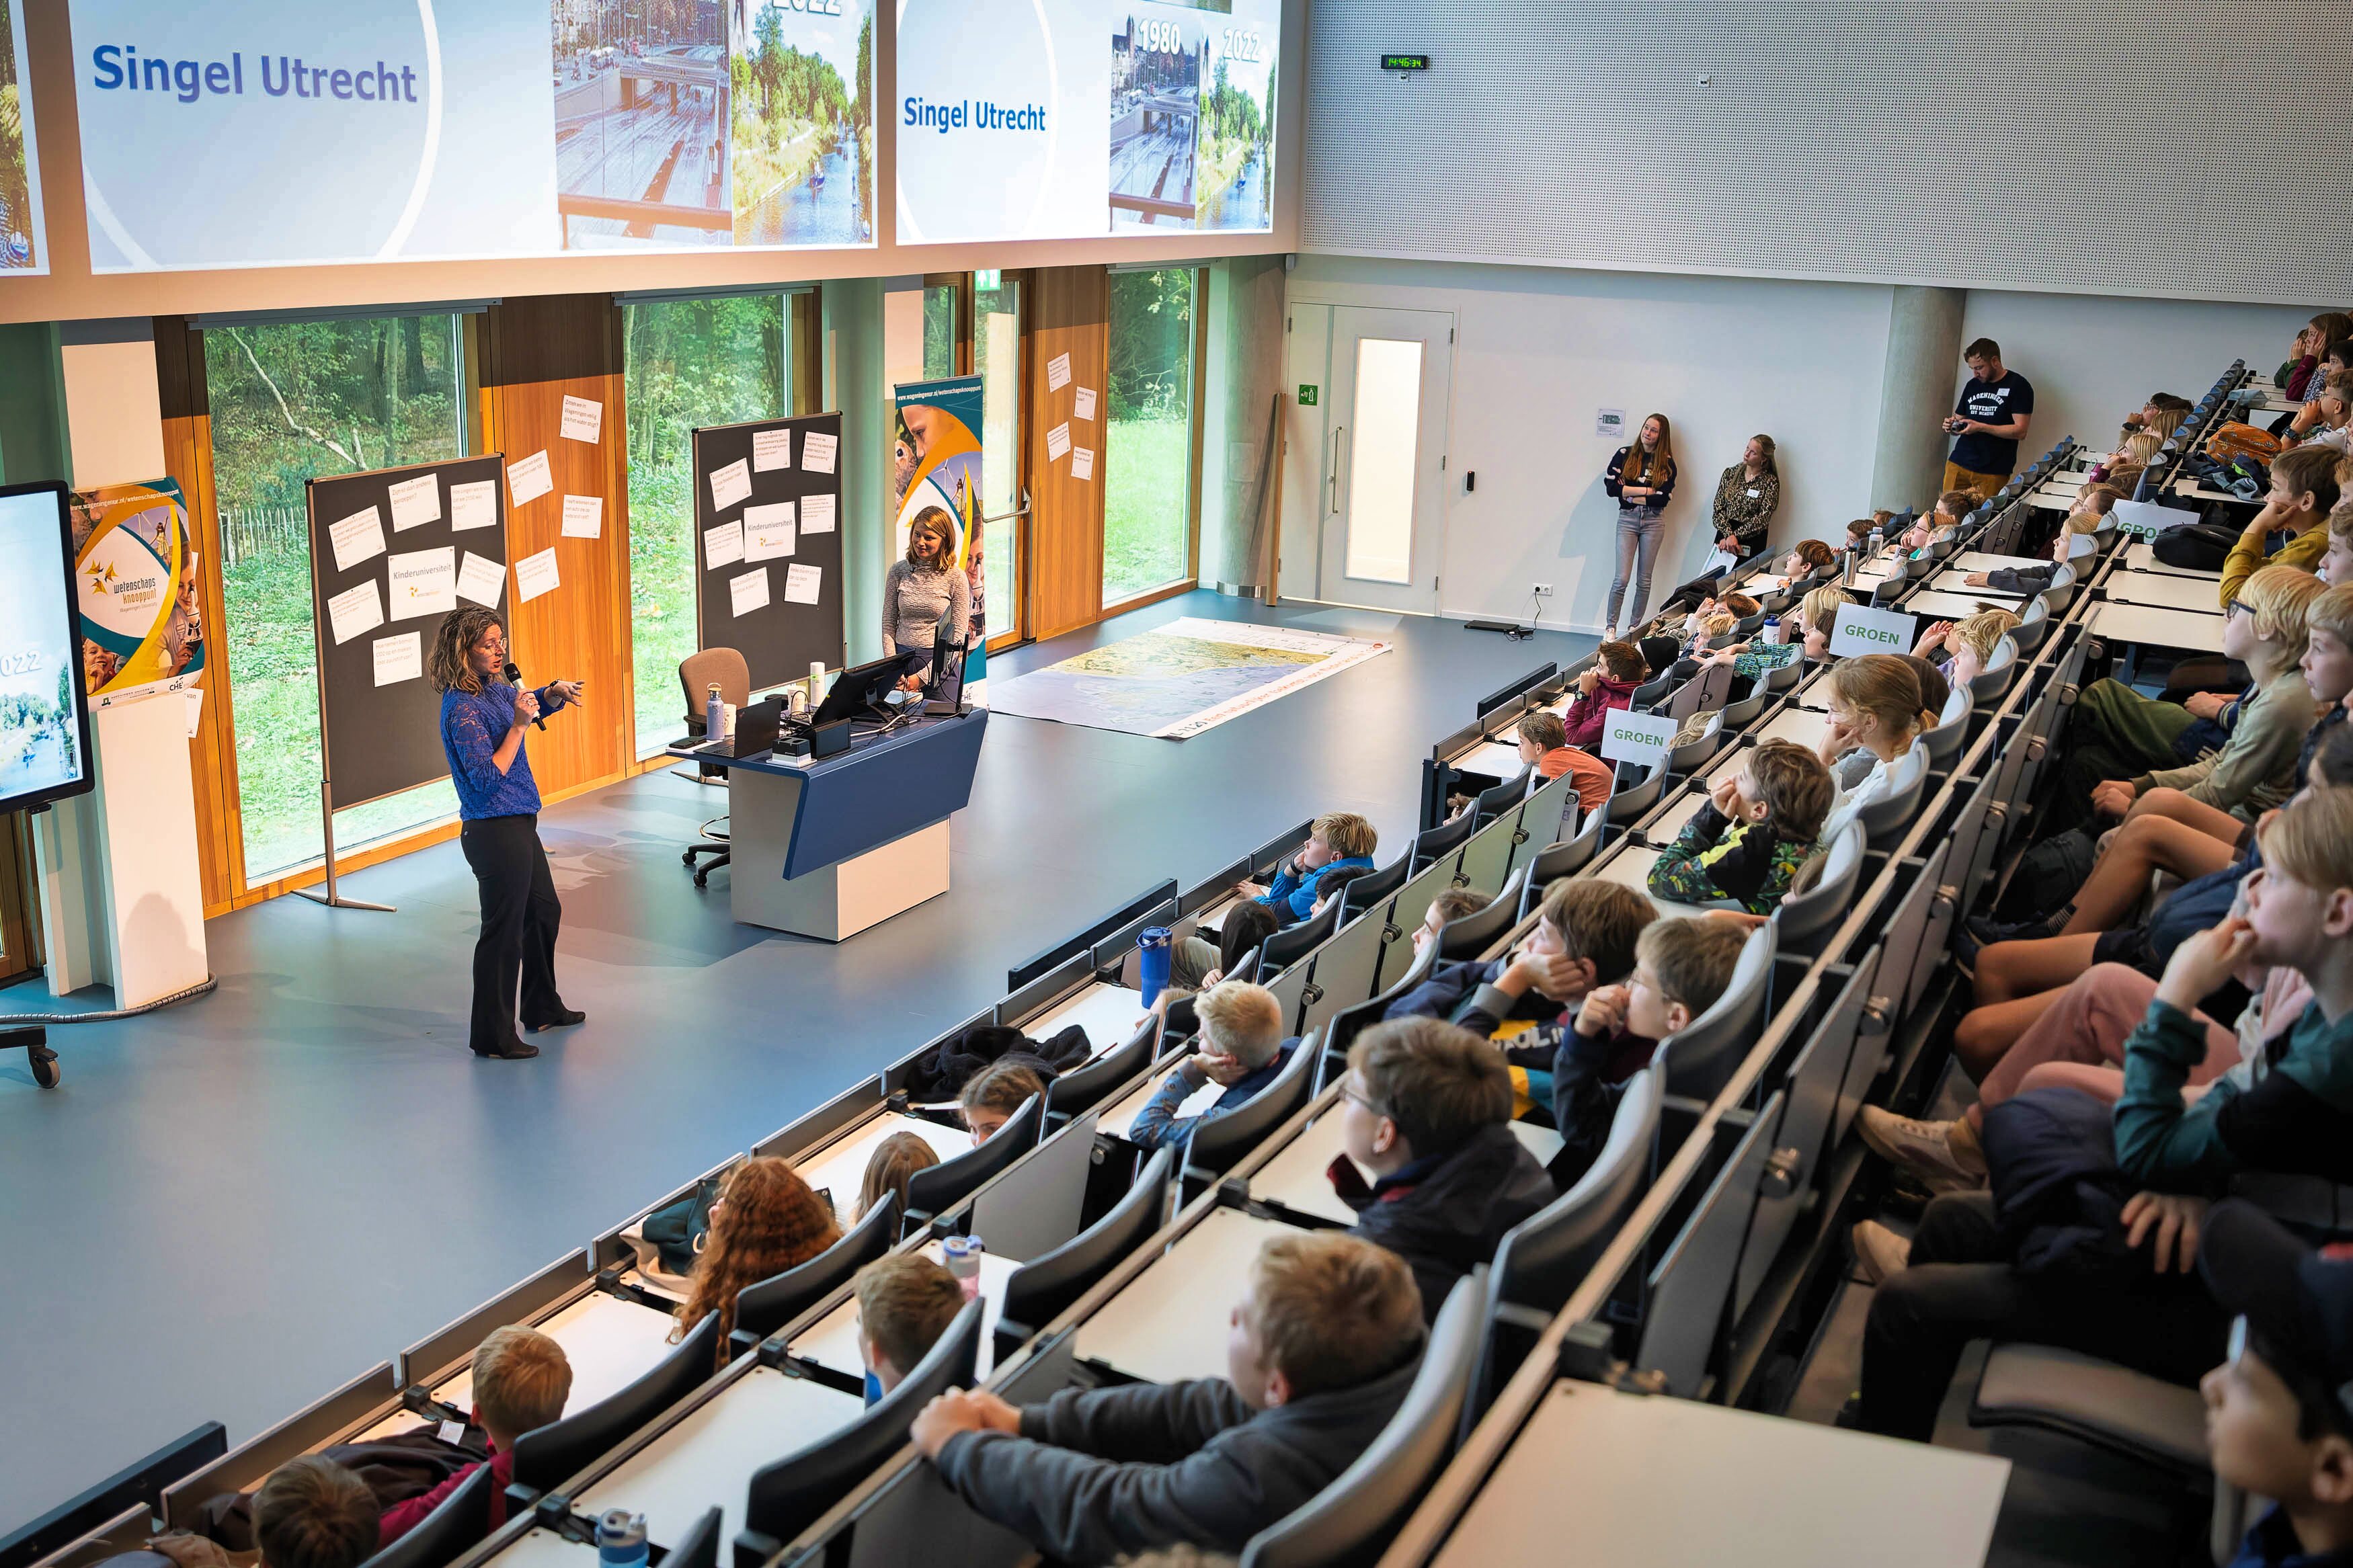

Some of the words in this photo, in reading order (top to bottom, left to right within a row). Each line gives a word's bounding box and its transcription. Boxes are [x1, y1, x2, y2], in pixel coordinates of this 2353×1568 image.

[1140, 19, 1181, 55] 1980
[1224, 28, 1259, 63] 2022
[1388, 58, 1421, 68] 14:46:34
[92, 44, 243, 104] Singel
[262, 56, 417, 103] Utrecht
[904, 97, 968, 133] Singel
[975, 101, 1046, 131] Utrecht
[1967, 393, 2004, 405] WAGENINGEN
[748, 520, 793, 532] Kinderuniversiteit
[2120, 522, 2163, 539] GRO
[393, 563, 452, 579] Kinderuniversiteit
[114, 577, 156, 594] wetenschaps
[122, 587, 157, 604] knooppunt
[1845, 624, 1900, 645] GROEN
[1613, 729, 1664, 747] GROEN
